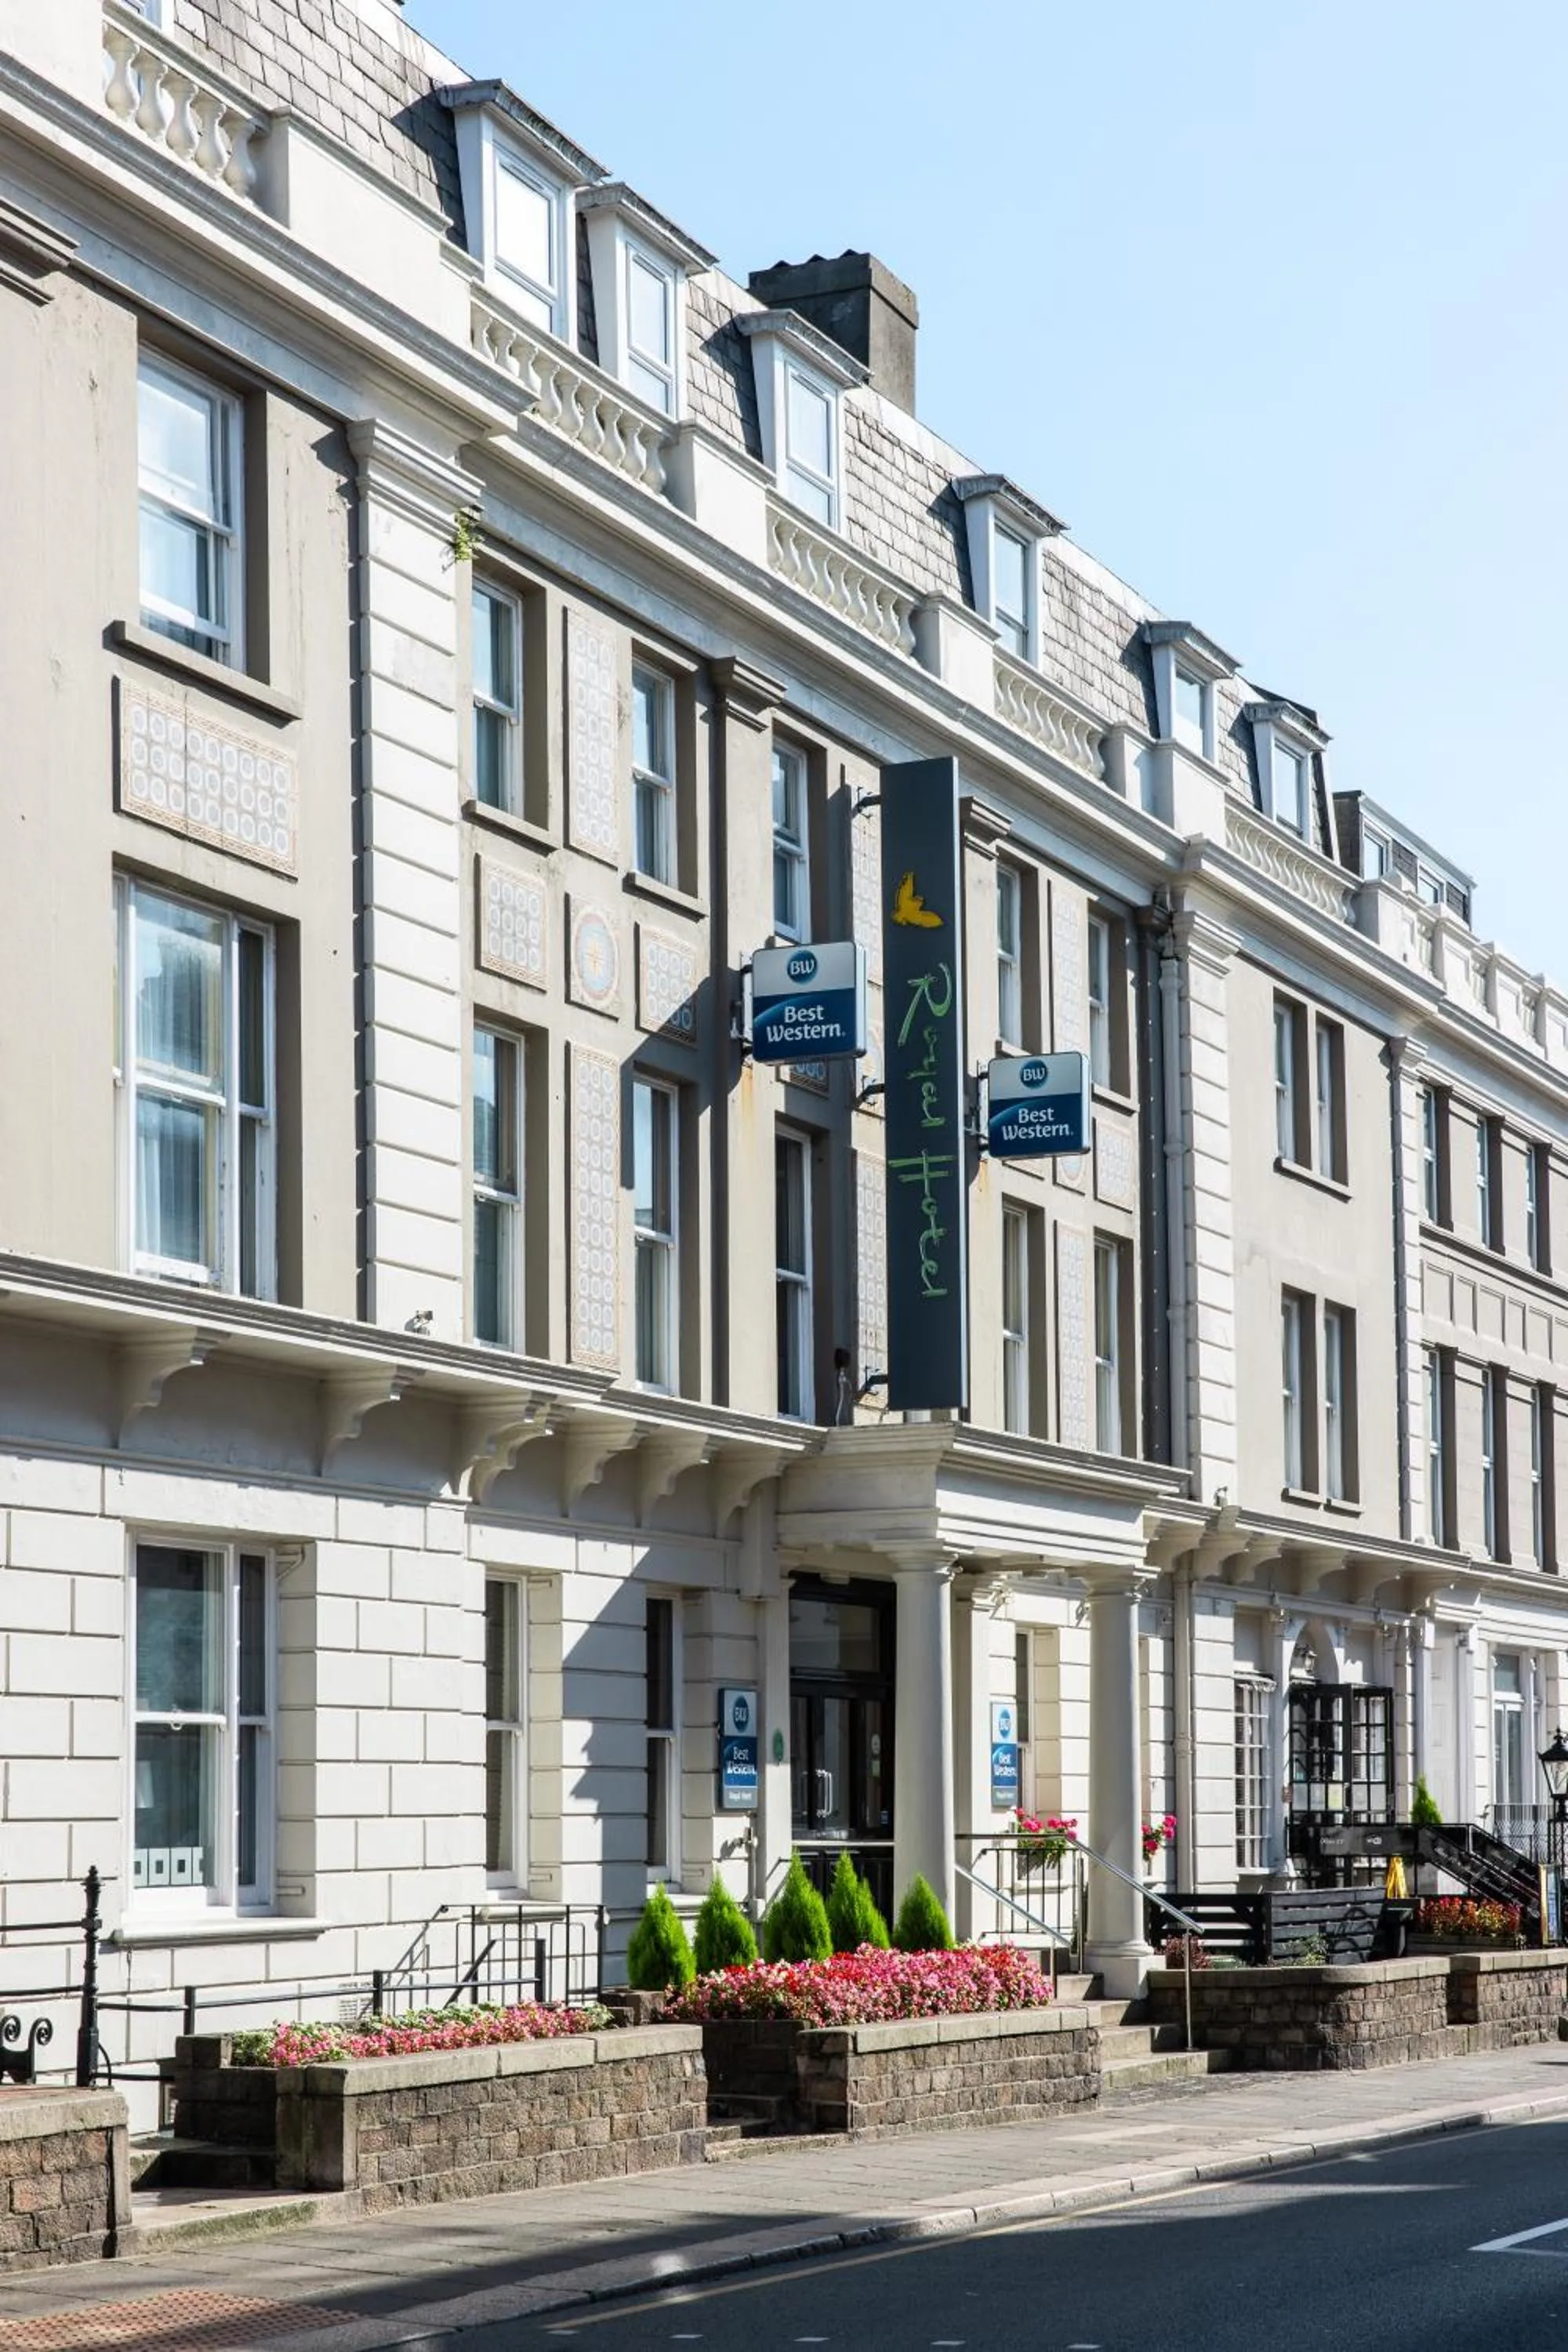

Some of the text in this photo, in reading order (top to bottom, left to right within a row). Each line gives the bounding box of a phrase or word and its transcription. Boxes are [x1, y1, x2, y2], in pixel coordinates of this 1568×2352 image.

[790, 959, 815, 975] BW
[785, 1004, 824, 1023] Best
[766, 1023, 841, 1043] Western
[1022, 1067, 1045, 1081] BW
[1018, 1107, 1054, 1123] Best
[888, 962, 956, 1298] Royal Hotel
[1002, 1123, 1070, 1141] Western
[733, 1747, 749, 1761] Best
